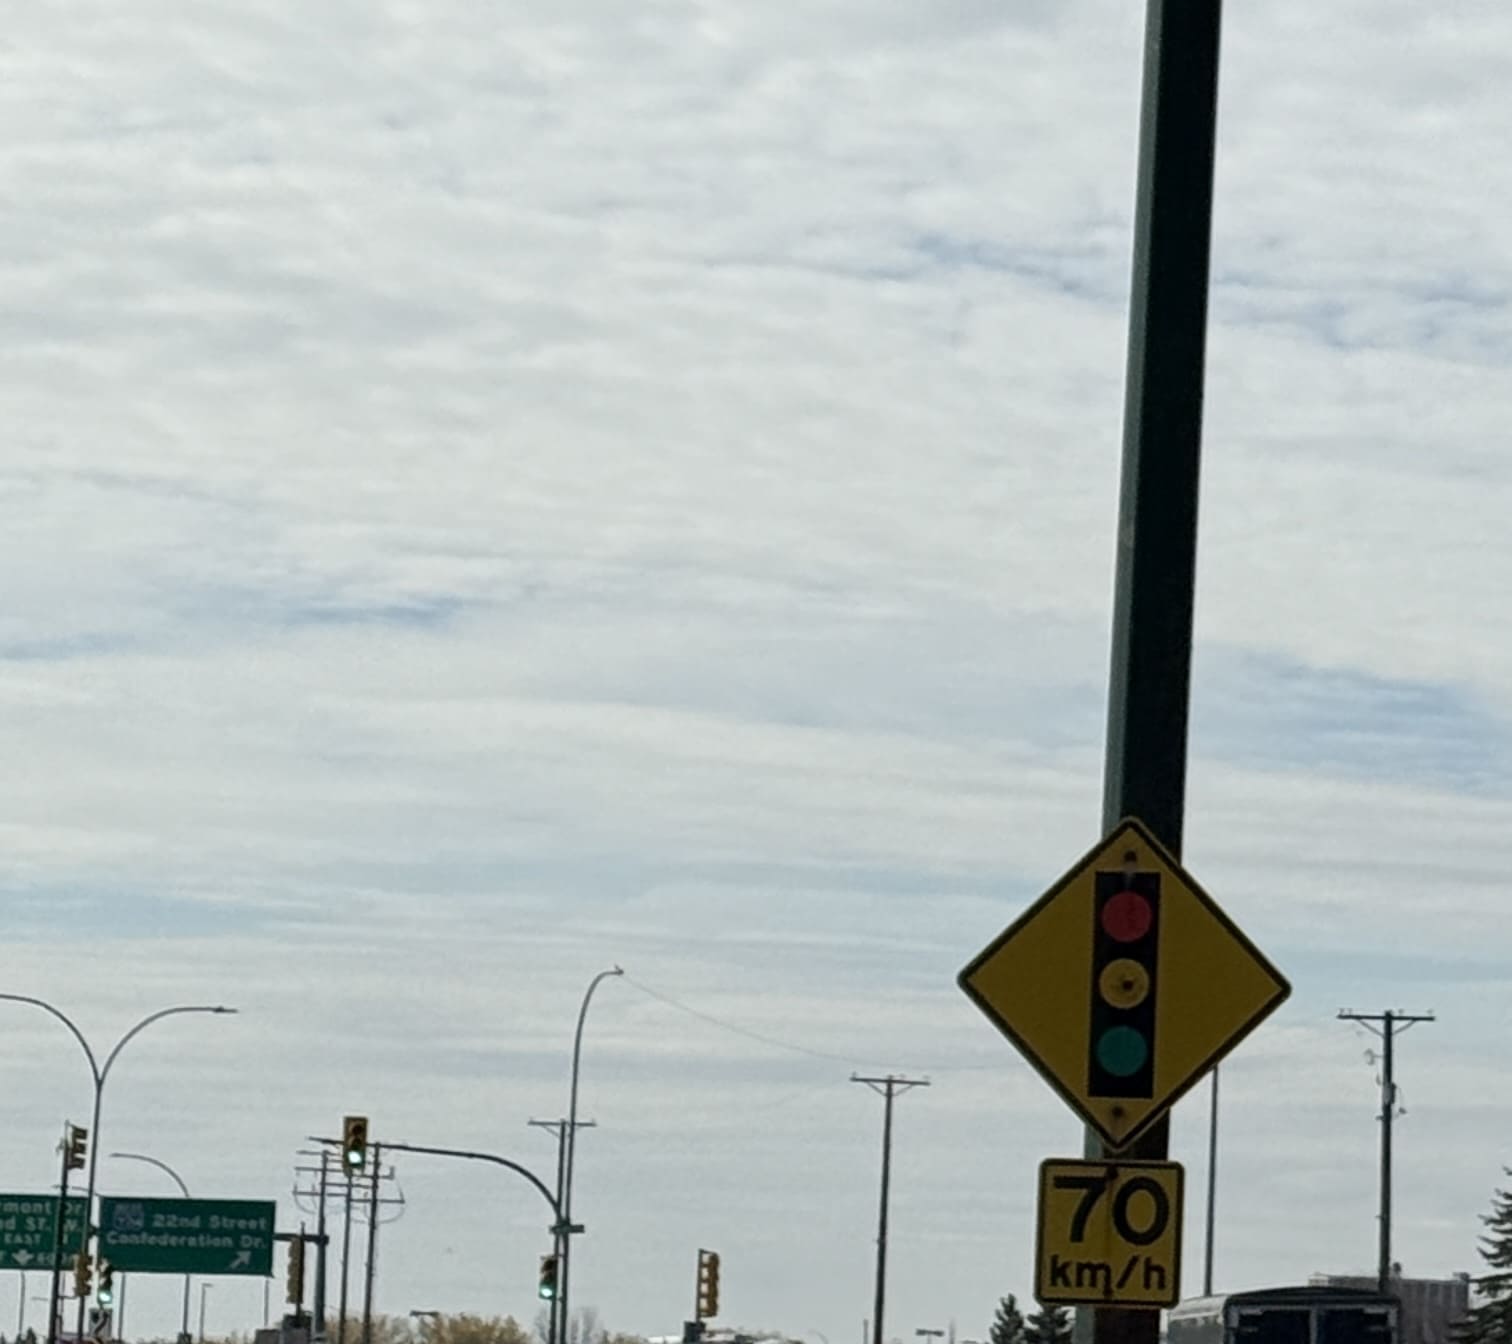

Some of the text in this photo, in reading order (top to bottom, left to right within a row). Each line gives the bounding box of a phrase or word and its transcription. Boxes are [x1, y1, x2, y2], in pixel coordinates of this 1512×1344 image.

[153, 1212, 201, 1229] 22nd
[209, 1214, 267, 1230] Street
[1053, 1175, 1169, 1246] 70
[106, 1230, 234, 1248] Confederation
[1050, 1255, 1167, 1291] km/h
